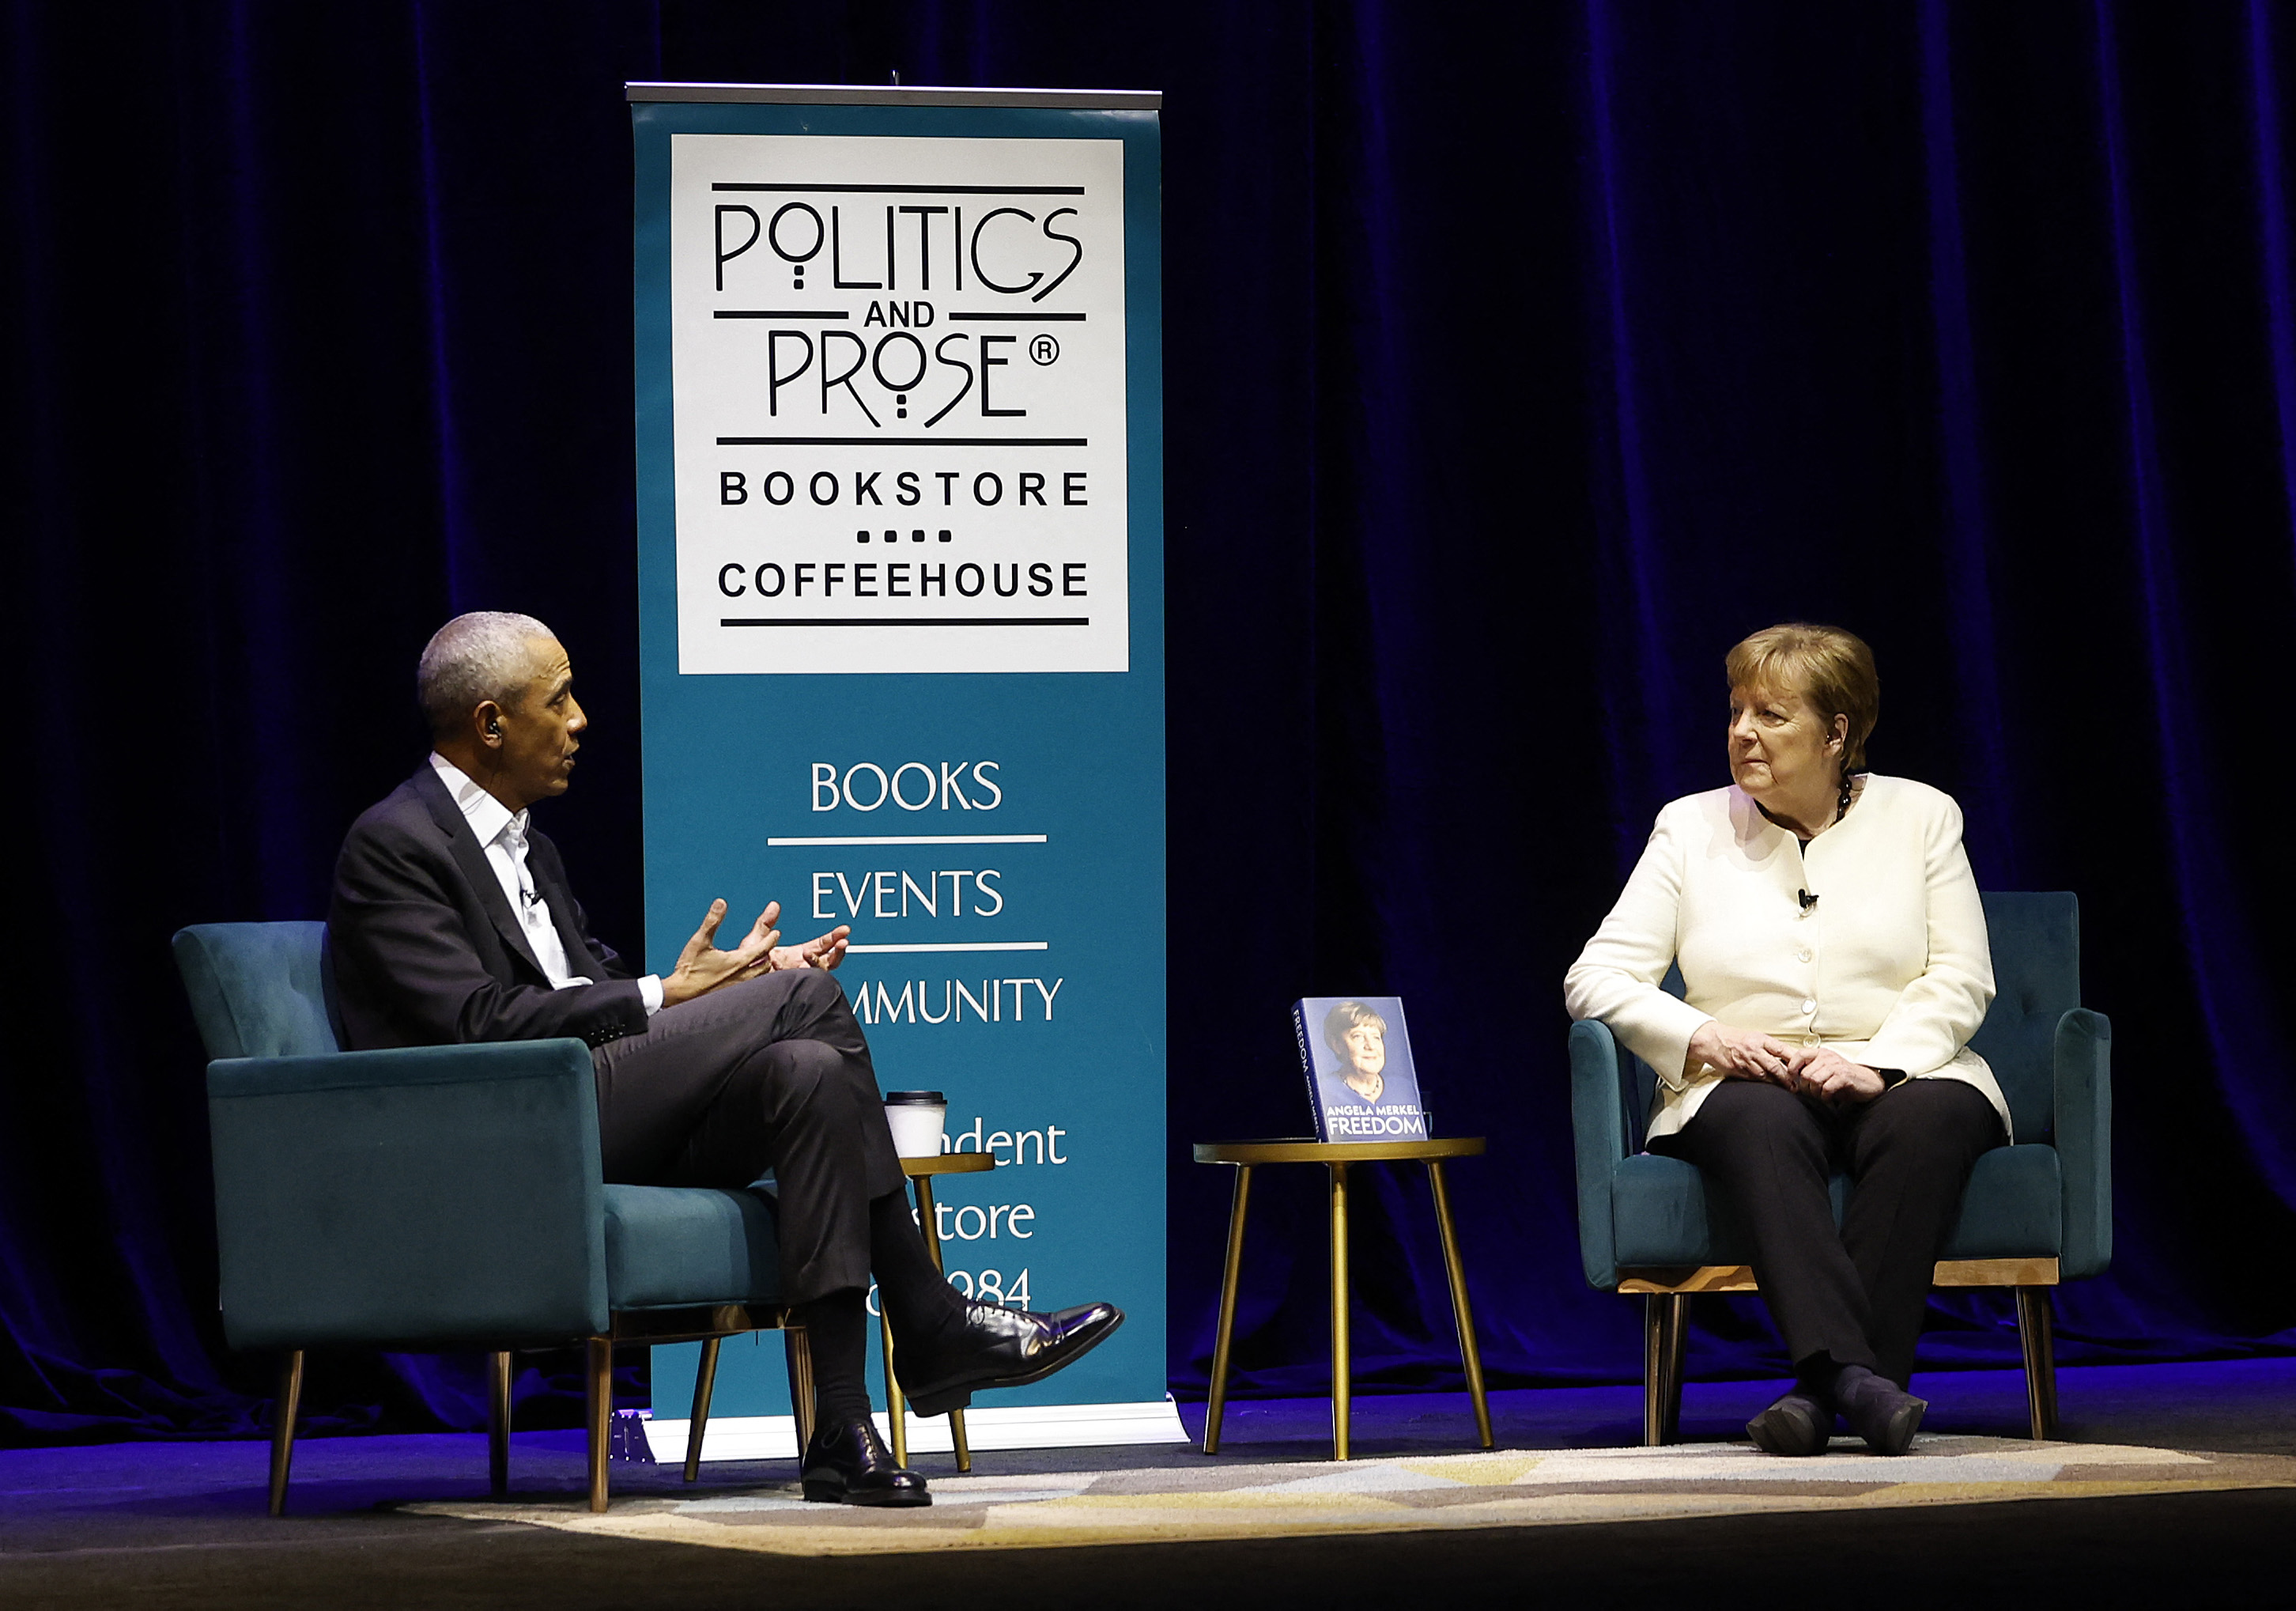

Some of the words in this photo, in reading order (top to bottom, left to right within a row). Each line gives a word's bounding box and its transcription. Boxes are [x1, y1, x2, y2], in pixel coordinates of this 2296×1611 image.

[715, 202, 1083, 303] POLITICS
[863, 301, 935, 328] AND
[720, 471, 1089, 506] BOOKSTORE
[718, 562, 1088, 598] COFFEEHOUSE
[812, 761, 1003, 811] BOOKS
[812, 869, 1003, 918] EVENTS
[852, 978, 1063, 1024] MMUNITY
[1293, 1009, 1308, 1072] FREEDOM
[1327, 1105, 1374, 1116] ANGELA
[1376, 1104, 1420, 1116] MERKEL
[1328, 1116, 1423, 1135] FREEDOM
